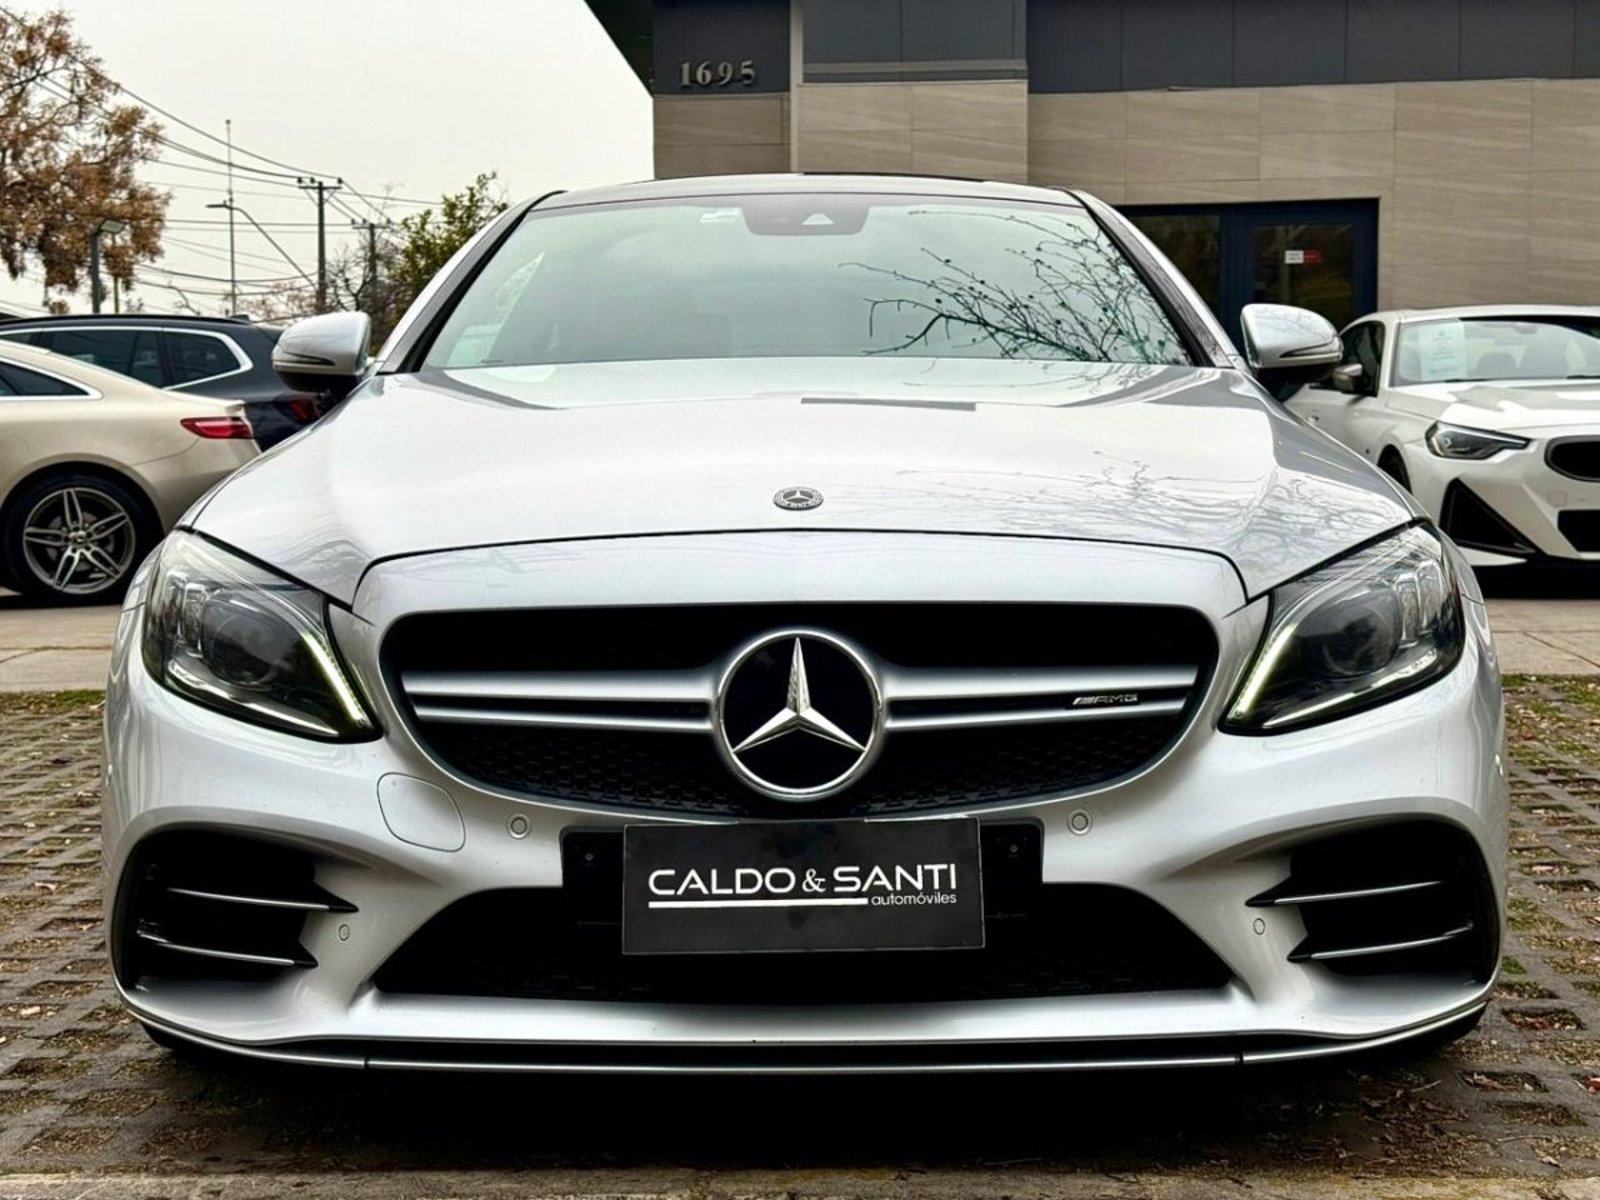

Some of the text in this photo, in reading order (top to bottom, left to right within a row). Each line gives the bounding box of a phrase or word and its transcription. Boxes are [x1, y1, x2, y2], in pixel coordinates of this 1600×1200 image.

[681, 60, 756, 86] 1695
[1090, 693, 1139, 705] AMG
[648, 863, 957, 896] CALDO & SANTI
[870, 891, 958, 907] automóviles
